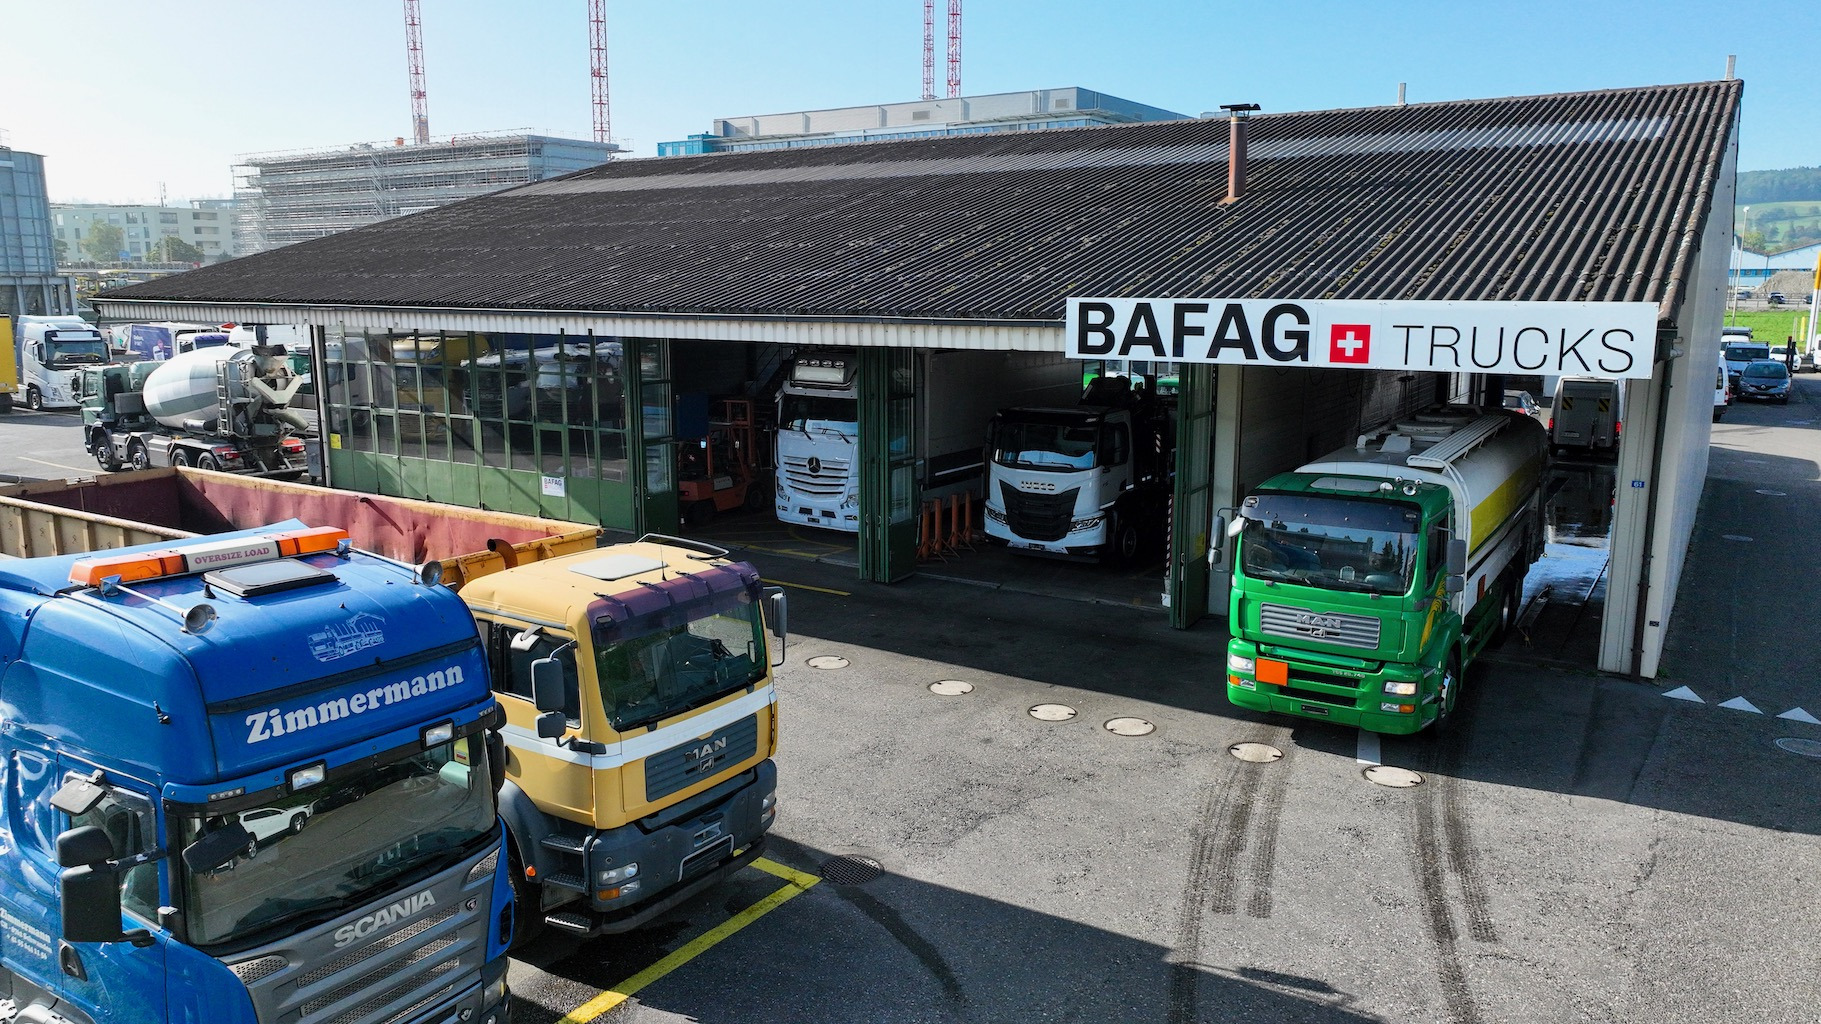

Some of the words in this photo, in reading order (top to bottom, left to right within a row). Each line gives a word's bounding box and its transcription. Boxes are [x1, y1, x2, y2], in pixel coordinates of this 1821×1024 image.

[1077, 302, 1310, 362] BAFAG
[1392, 325, 1634, 373] TRUCKS
[1021, 481, 1055, 490] IVECO
[194, 551, 242, 565] OVERSIZE
[244, 547, 270, 557] LOAD
[1296, 613, 1341, 628] MAN
[245, 665, 465, 744] Zimmermann
[684, 736, 727, 761] MAN
[0, 907, 51, 944] Zimmermann
[334, 889, 437, 948] SCANIA
